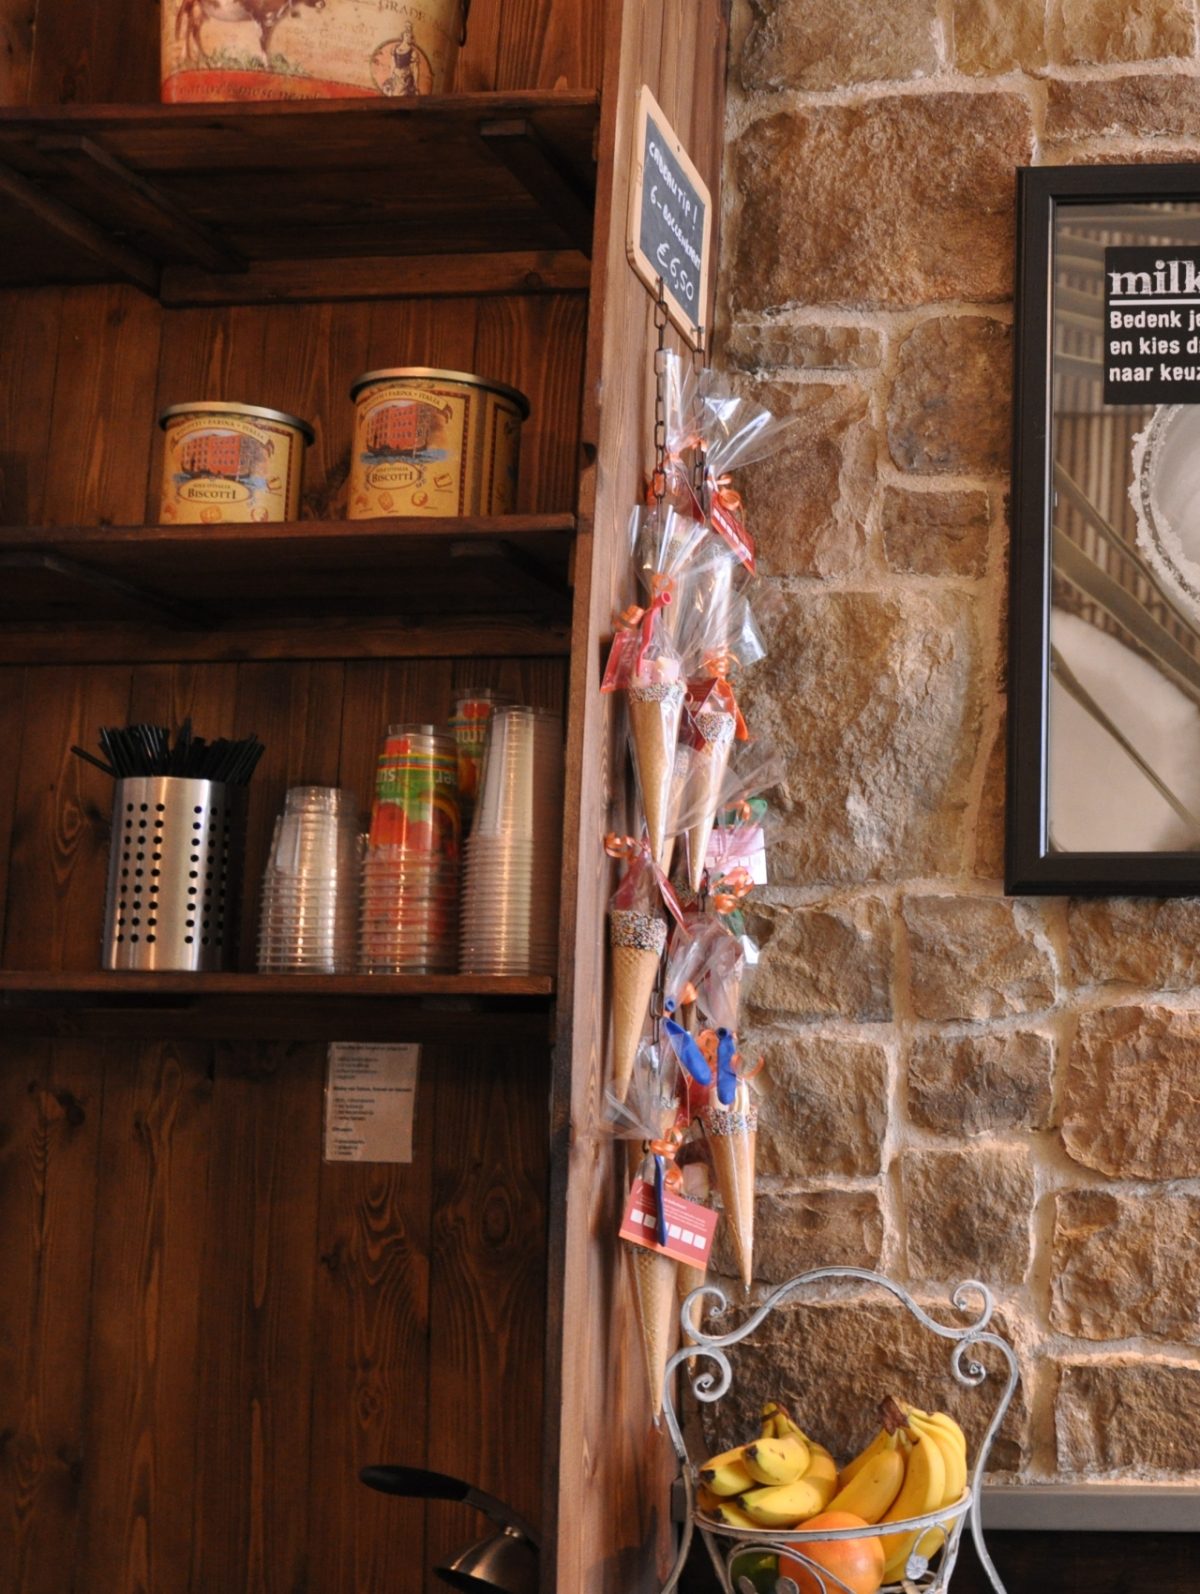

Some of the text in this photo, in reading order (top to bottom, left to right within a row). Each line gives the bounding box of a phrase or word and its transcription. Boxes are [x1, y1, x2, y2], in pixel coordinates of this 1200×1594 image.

[1110, 310, 1182, 329] Bedenk
[1109, 340, 1133, 356] en
[1139, 336, 1181, 355] kies
[1109, 365, 1154, 382] naar
[188, 487, 237, 500] BISCOTTI
